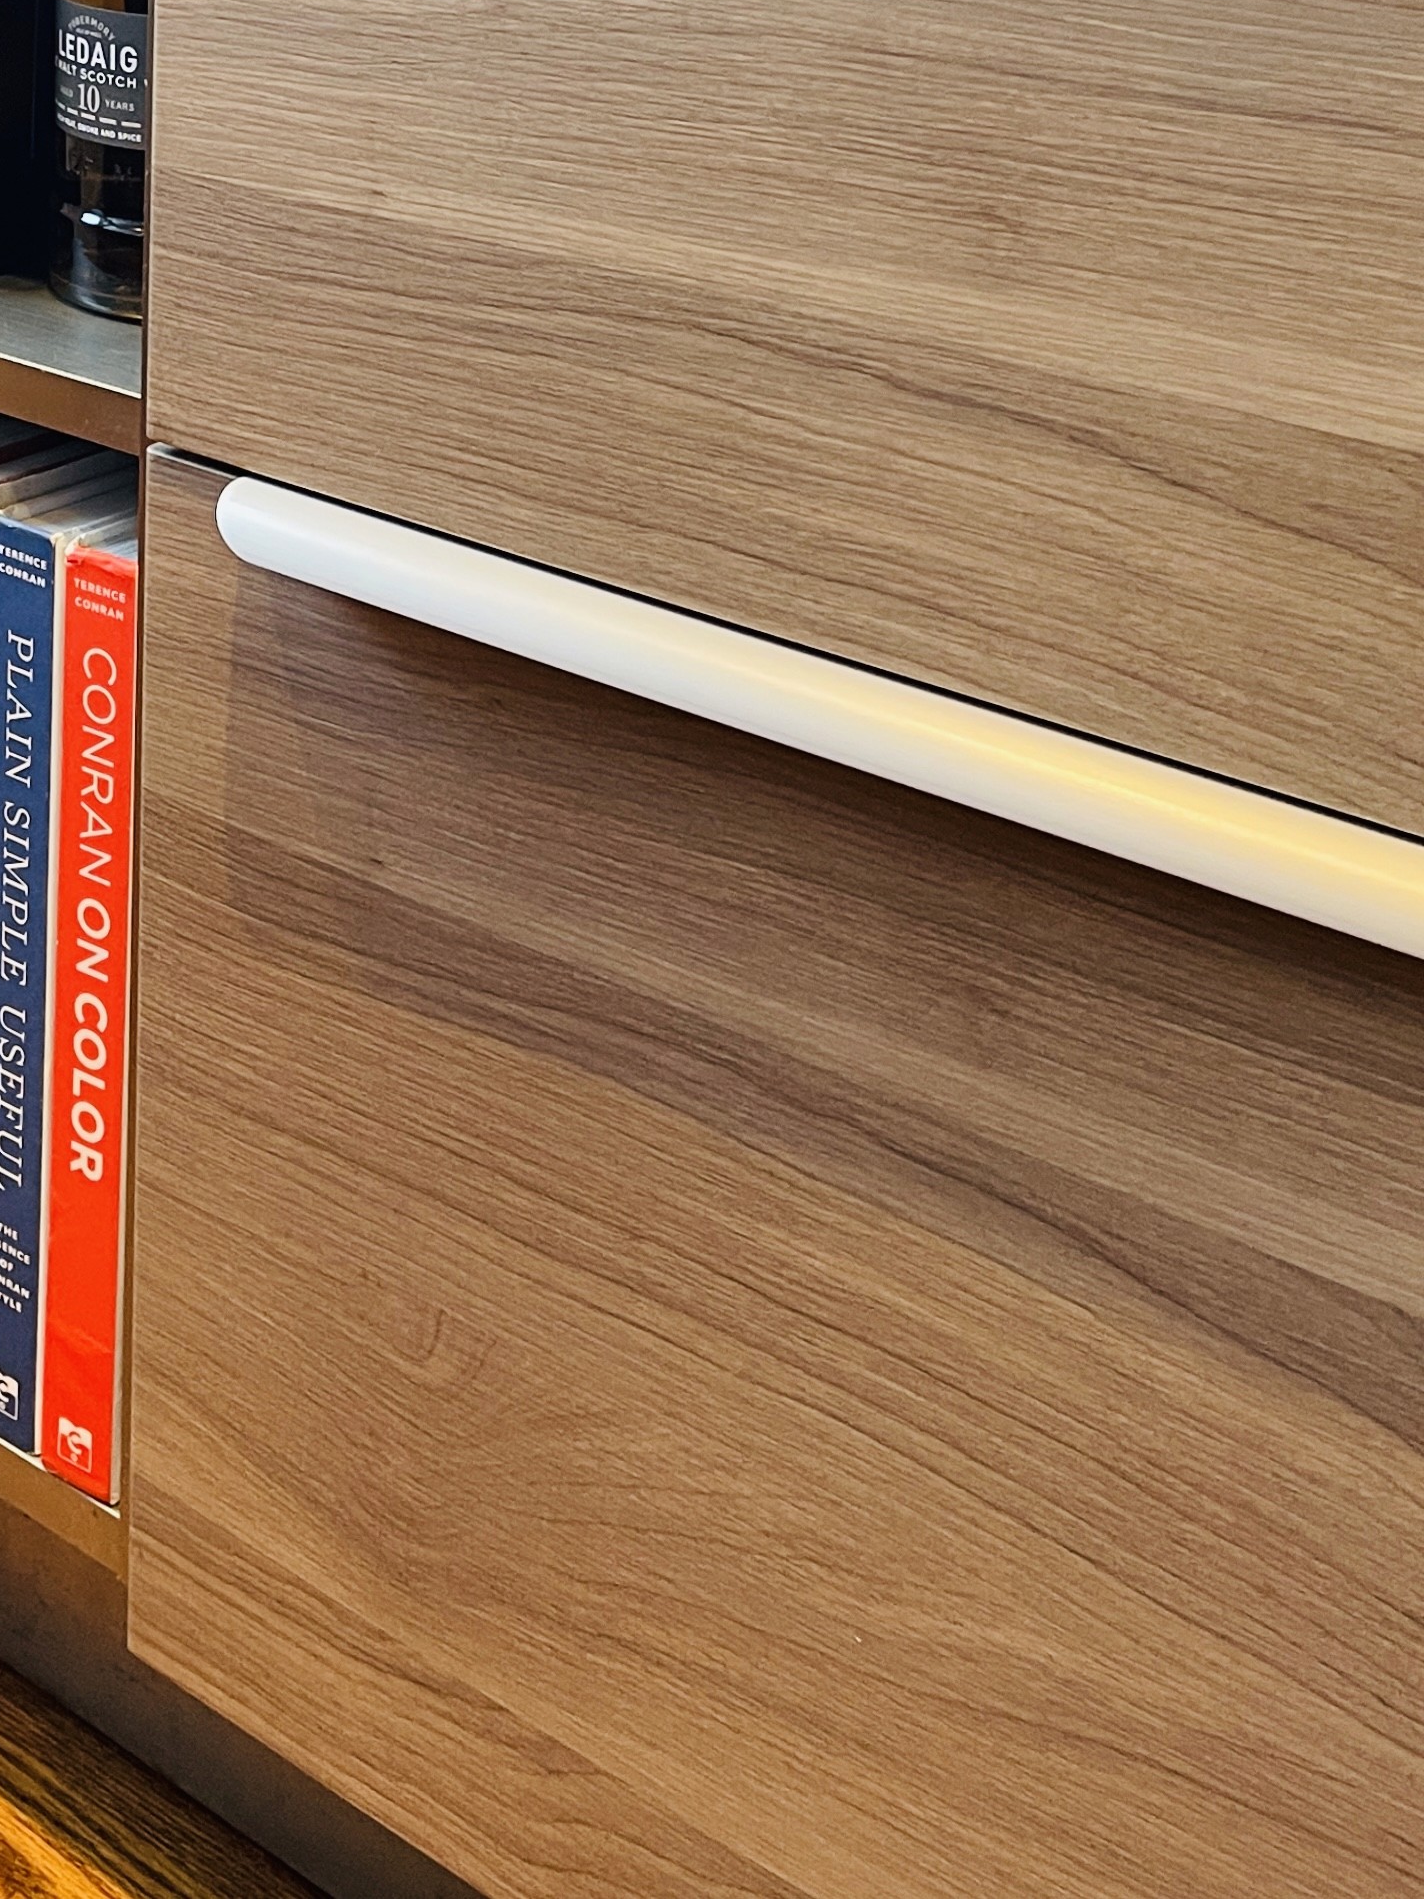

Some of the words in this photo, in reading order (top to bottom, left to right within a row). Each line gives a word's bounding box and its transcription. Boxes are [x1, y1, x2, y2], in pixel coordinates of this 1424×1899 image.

[68, 15, 115, 41] TOBERMORY
[59, 29, 138, 73] LEDAIG
[58, 59, 77, 76] MALT
[80, 68, 136, 89] SCOTCH
[78, 83, 101, 113] 10
[104, 99, 135, 112] YEARS
[100, 128, 116, 139] AND
[117, 131, 142, 143] SPICE
[74, 577, 126, 604] TERENCE
[74, 596, 124, 621] CONRAN
[5, 629, 34, 789] PLAIN
[78, 647, 117, 888] CONRAN
[0, 801, 31, 987] SIMPLE
[75, 897, 111, 983] ON
[69, 992, 108, 1183] COLOR
[0, 1258, 14, 1272] OF
